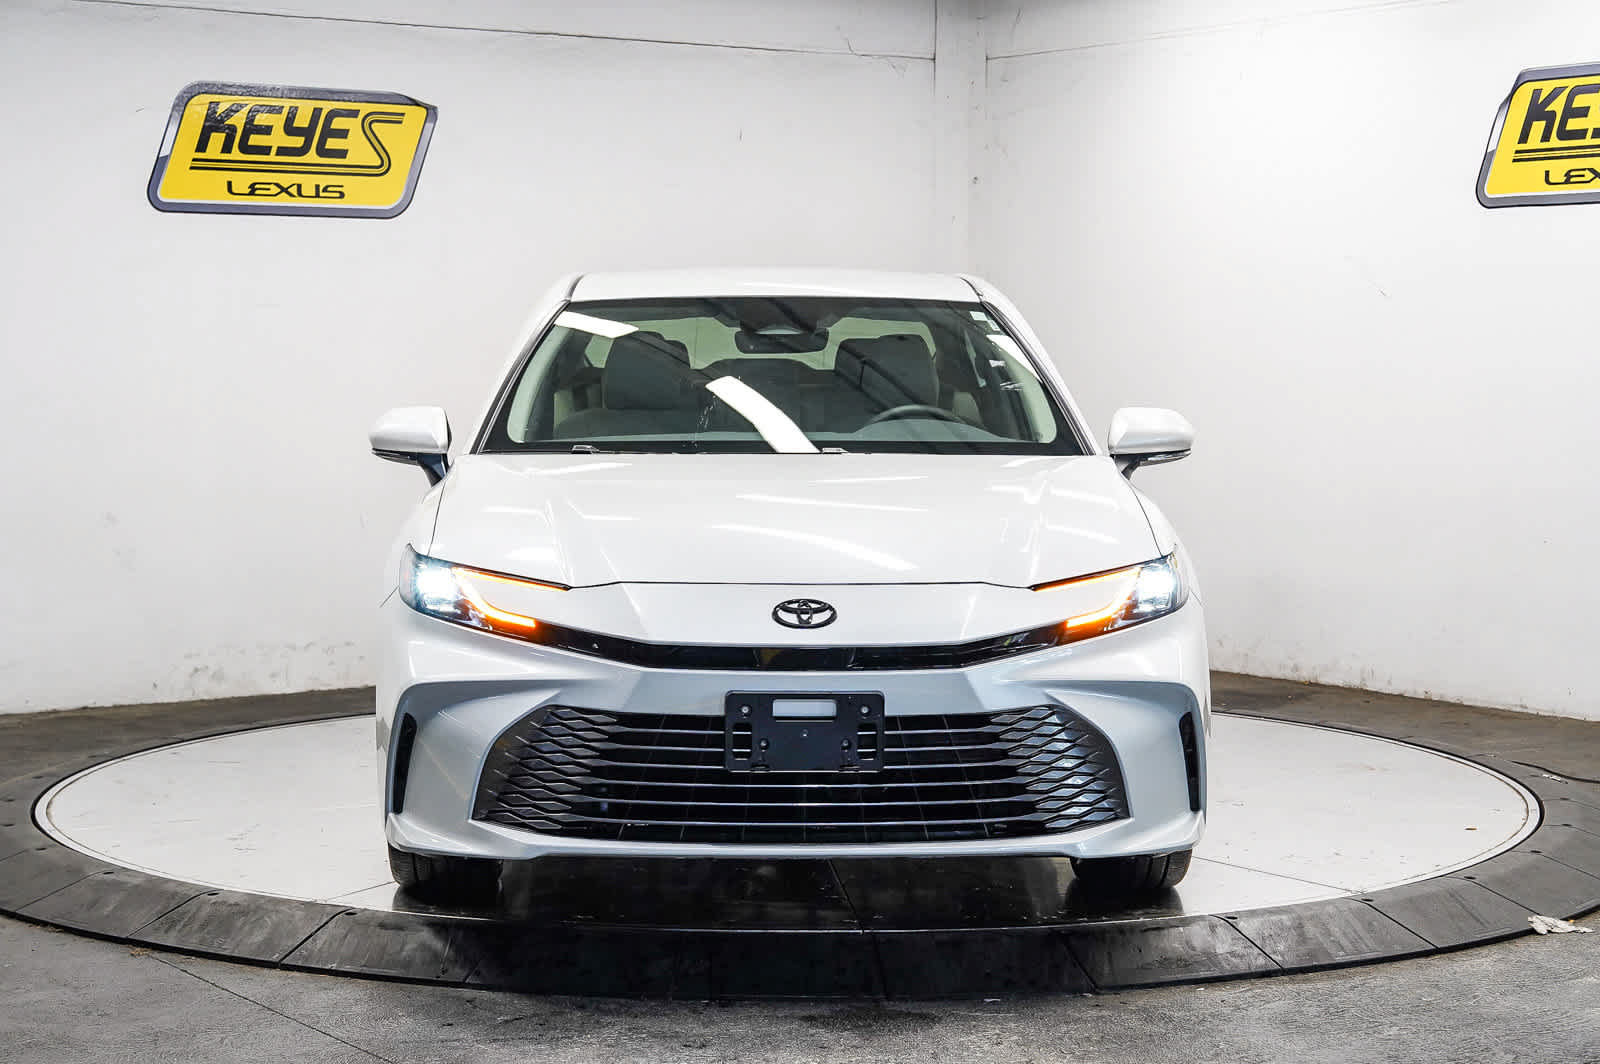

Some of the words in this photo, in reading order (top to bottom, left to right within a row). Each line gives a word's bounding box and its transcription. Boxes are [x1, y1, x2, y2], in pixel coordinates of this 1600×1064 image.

[193, 100, 406, 176] KEYES
[1517, 83, 1600, 144] KE
[226, 180, 345, 199] LEXUS
